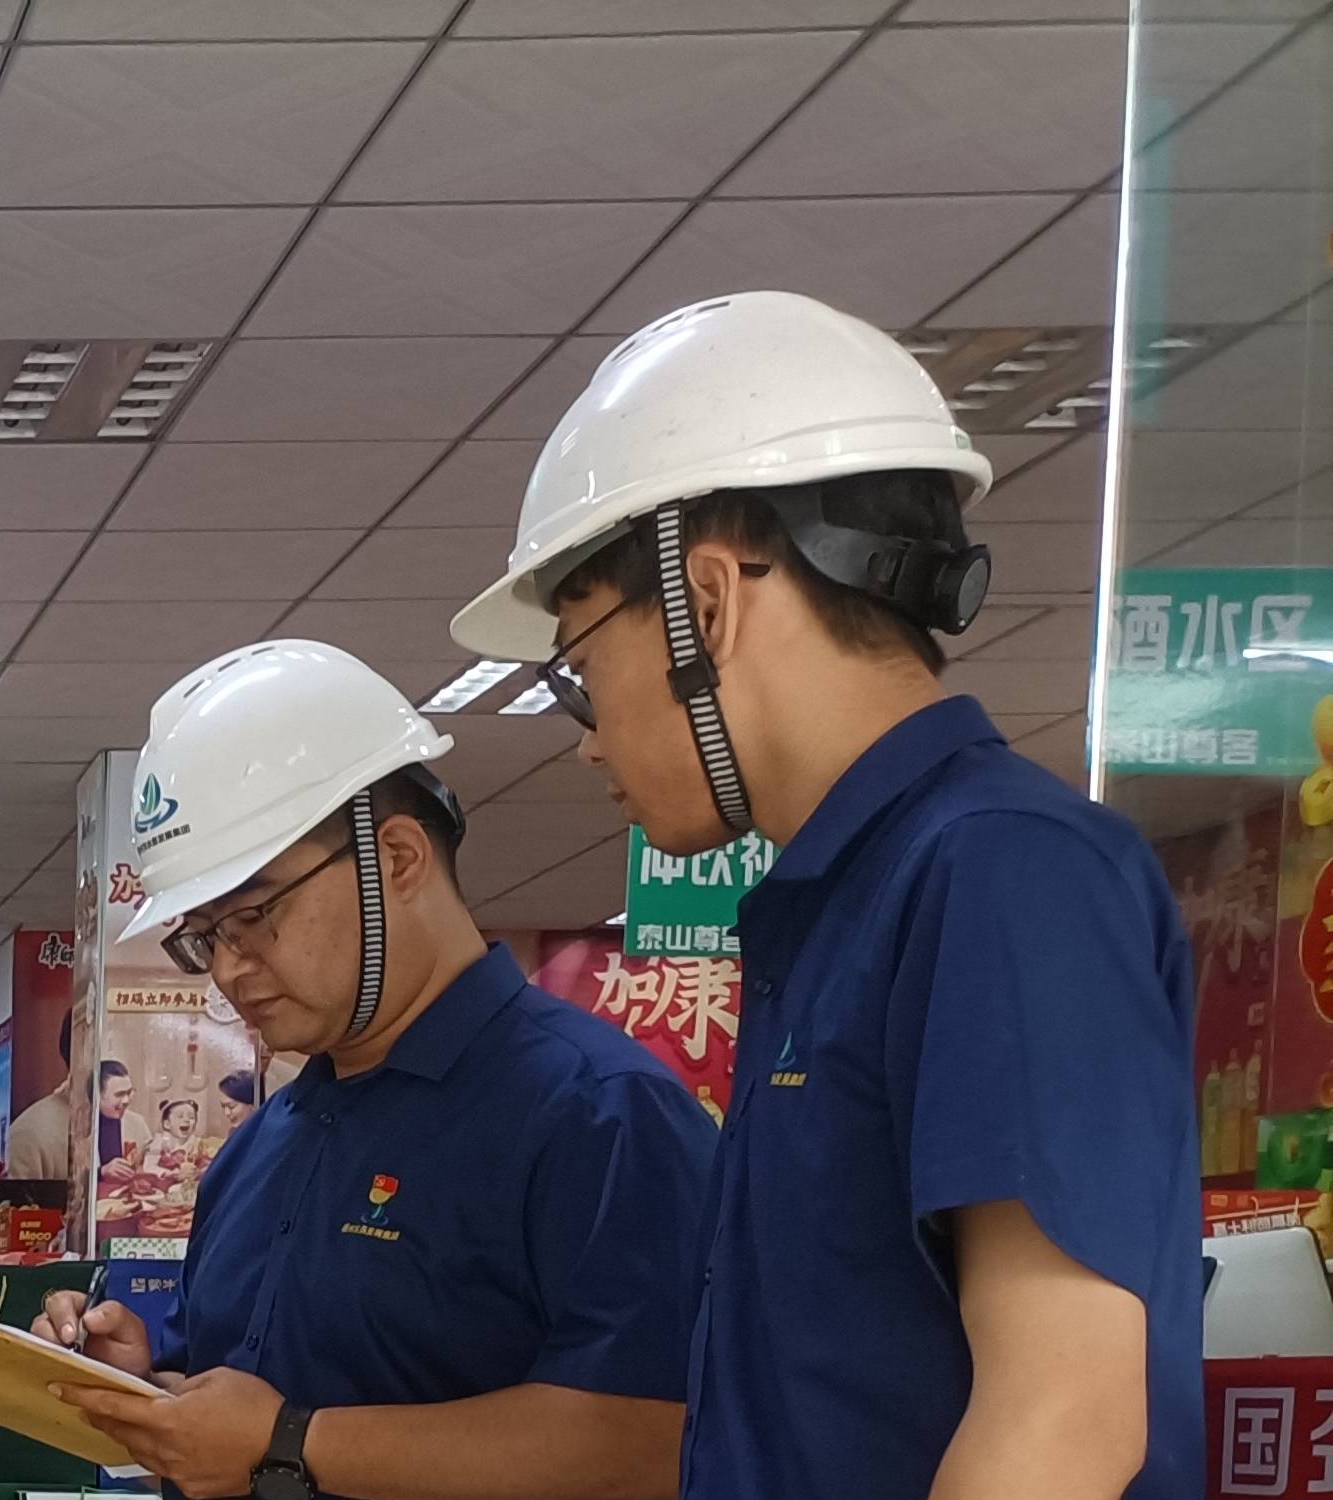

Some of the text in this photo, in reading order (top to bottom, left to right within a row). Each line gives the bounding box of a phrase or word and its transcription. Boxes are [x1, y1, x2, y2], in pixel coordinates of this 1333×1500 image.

[117, 991, 199, 1007] 扫码立即参与
[592, 953, 742, 1060] 加康
